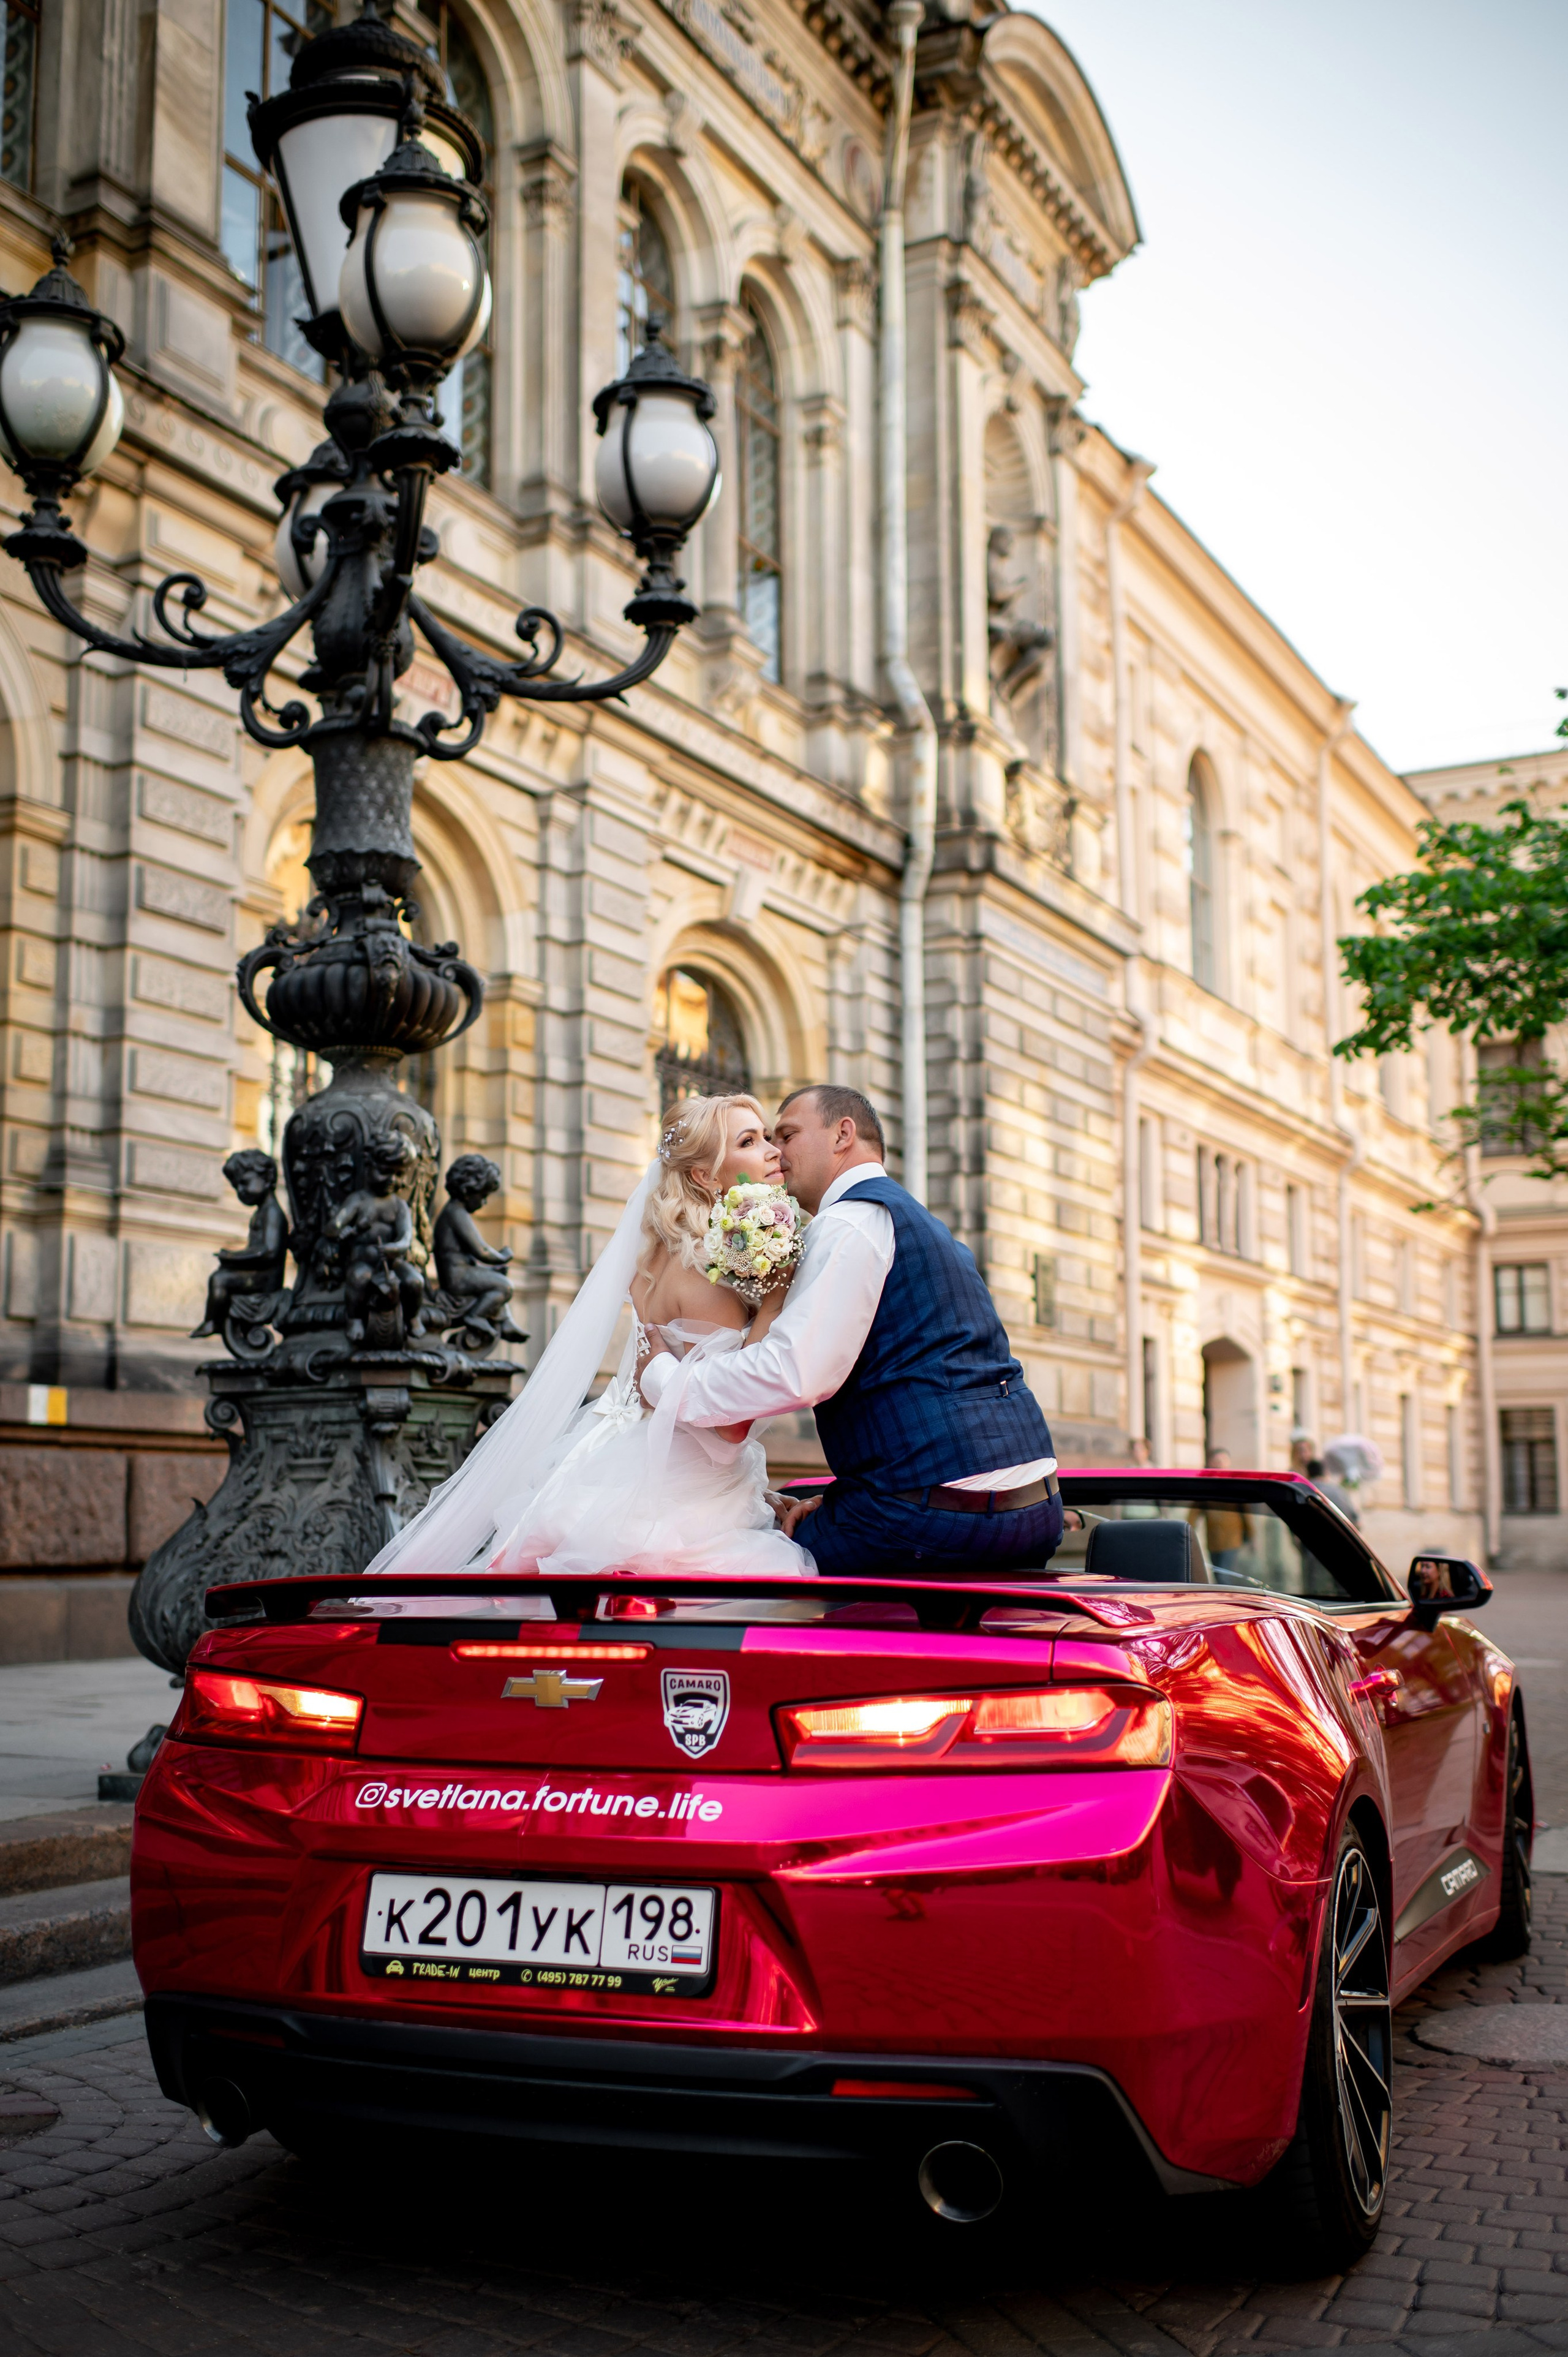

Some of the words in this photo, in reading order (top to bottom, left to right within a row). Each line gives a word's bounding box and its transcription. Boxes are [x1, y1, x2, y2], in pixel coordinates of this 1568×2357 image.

[669, 1678, 721, 1691] CAMARO
[685, 1734, 706, 1746] SPB
[383, 1784, 723, 1822] svetlana.fortune.life
[1441, 1858, 1478, 1896] CAMARO
[612, 1893, 694, 1941] 198
[627, 1944, 668, 1962] RUS
[412, 1962, 461, 1978] TRADE-IN
[468, 1967, 500, 1981] центр
[537, 1970, 567, 1985] (495)
[568, 1972, 589, 1986] 787
[591, 1974, 605, 1986] 77
[607, 1975, 622, 1988] 99
